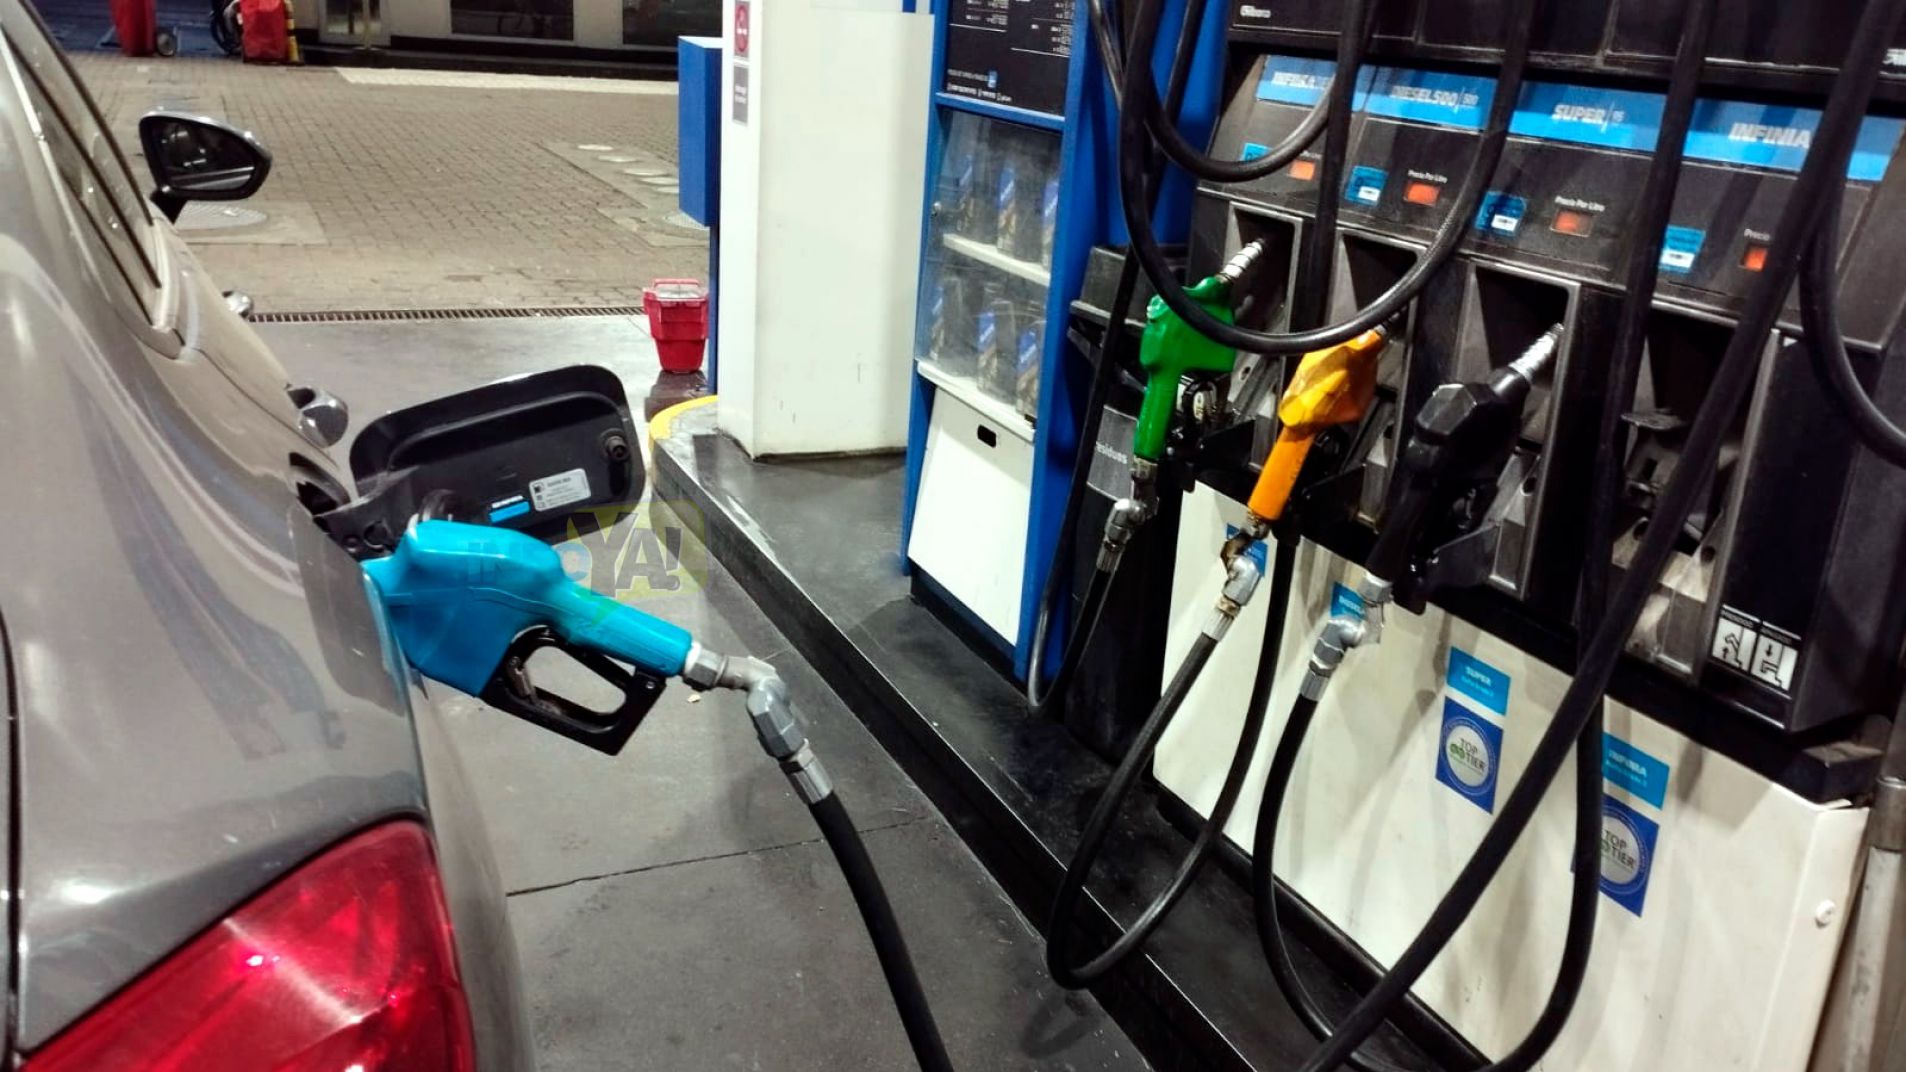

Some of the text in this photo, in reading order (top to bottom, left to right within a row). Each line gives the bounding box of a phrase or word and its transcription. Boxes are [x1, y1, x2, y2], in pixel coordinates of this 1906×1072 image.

[1551, 103, 1606, 124] SUPER
[1728, 121, 1811, 149] INFINIA
[1743, 228, 1771, 242] Precio
[1464, 665, 1492, 687] SUPER
[1458, 737, 1479, 756] TOP
[1466, 752, 1487, 773] TIER
[1604, 829, 1628, 851] TOP
[1611, 846, 1635, 869] TIER
